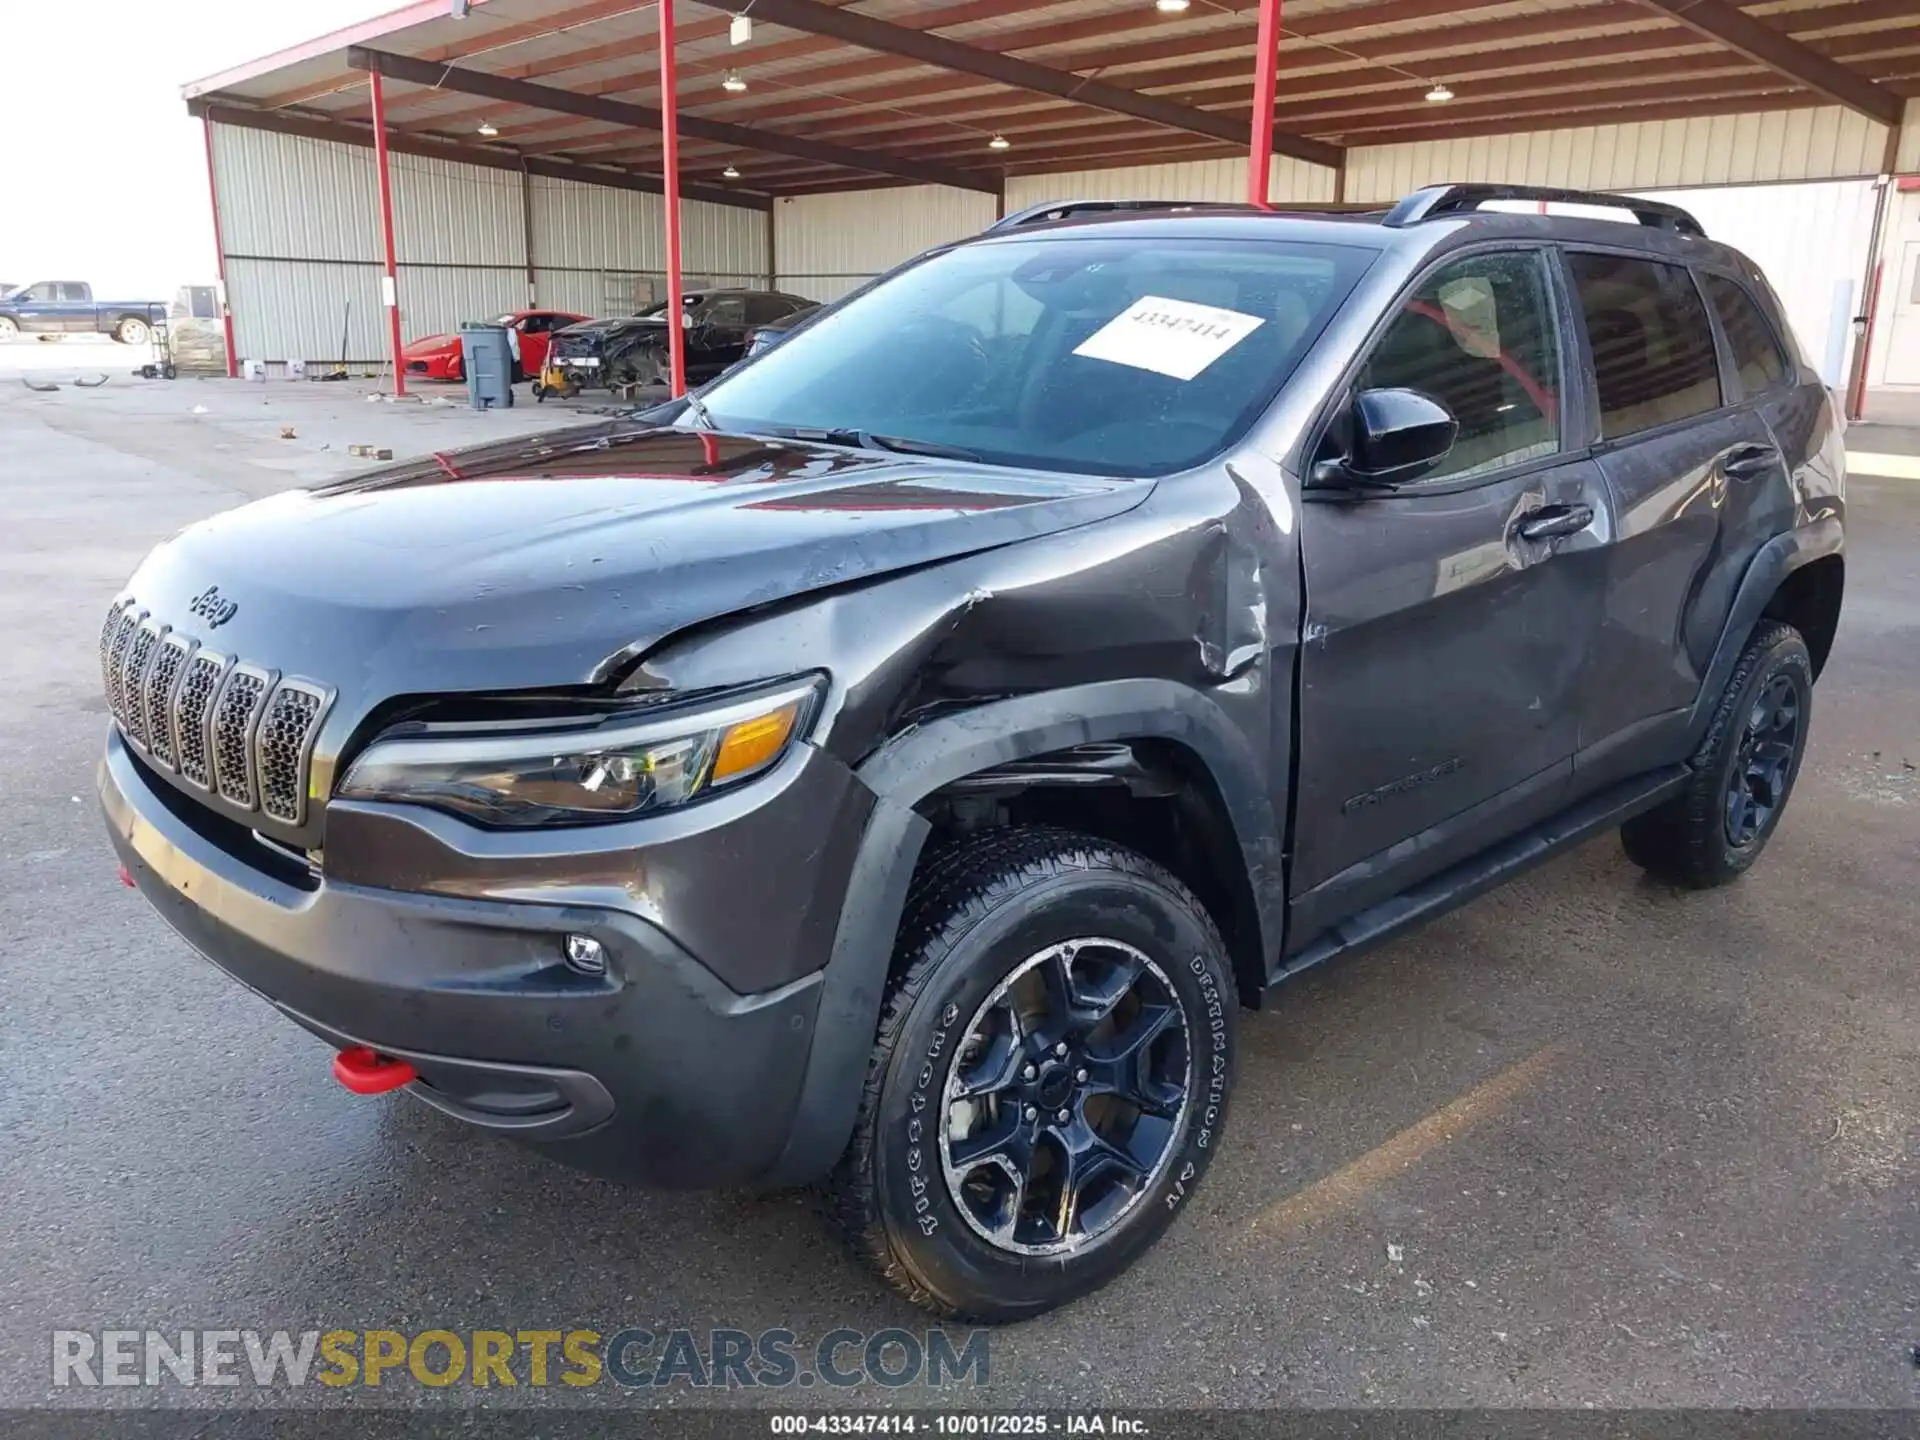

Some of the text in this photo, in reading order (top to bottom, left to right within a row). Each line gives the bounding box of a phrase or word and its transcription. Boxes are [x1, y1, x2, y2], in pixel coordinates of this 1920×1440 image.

[1132, 311, 1231, 341] 43347414
[189, 585, 239, 630] Jeep
[906, 1001, 959, 1237] Firestone
[1166, 955, 1226, 1211] DESTINATION A/T
